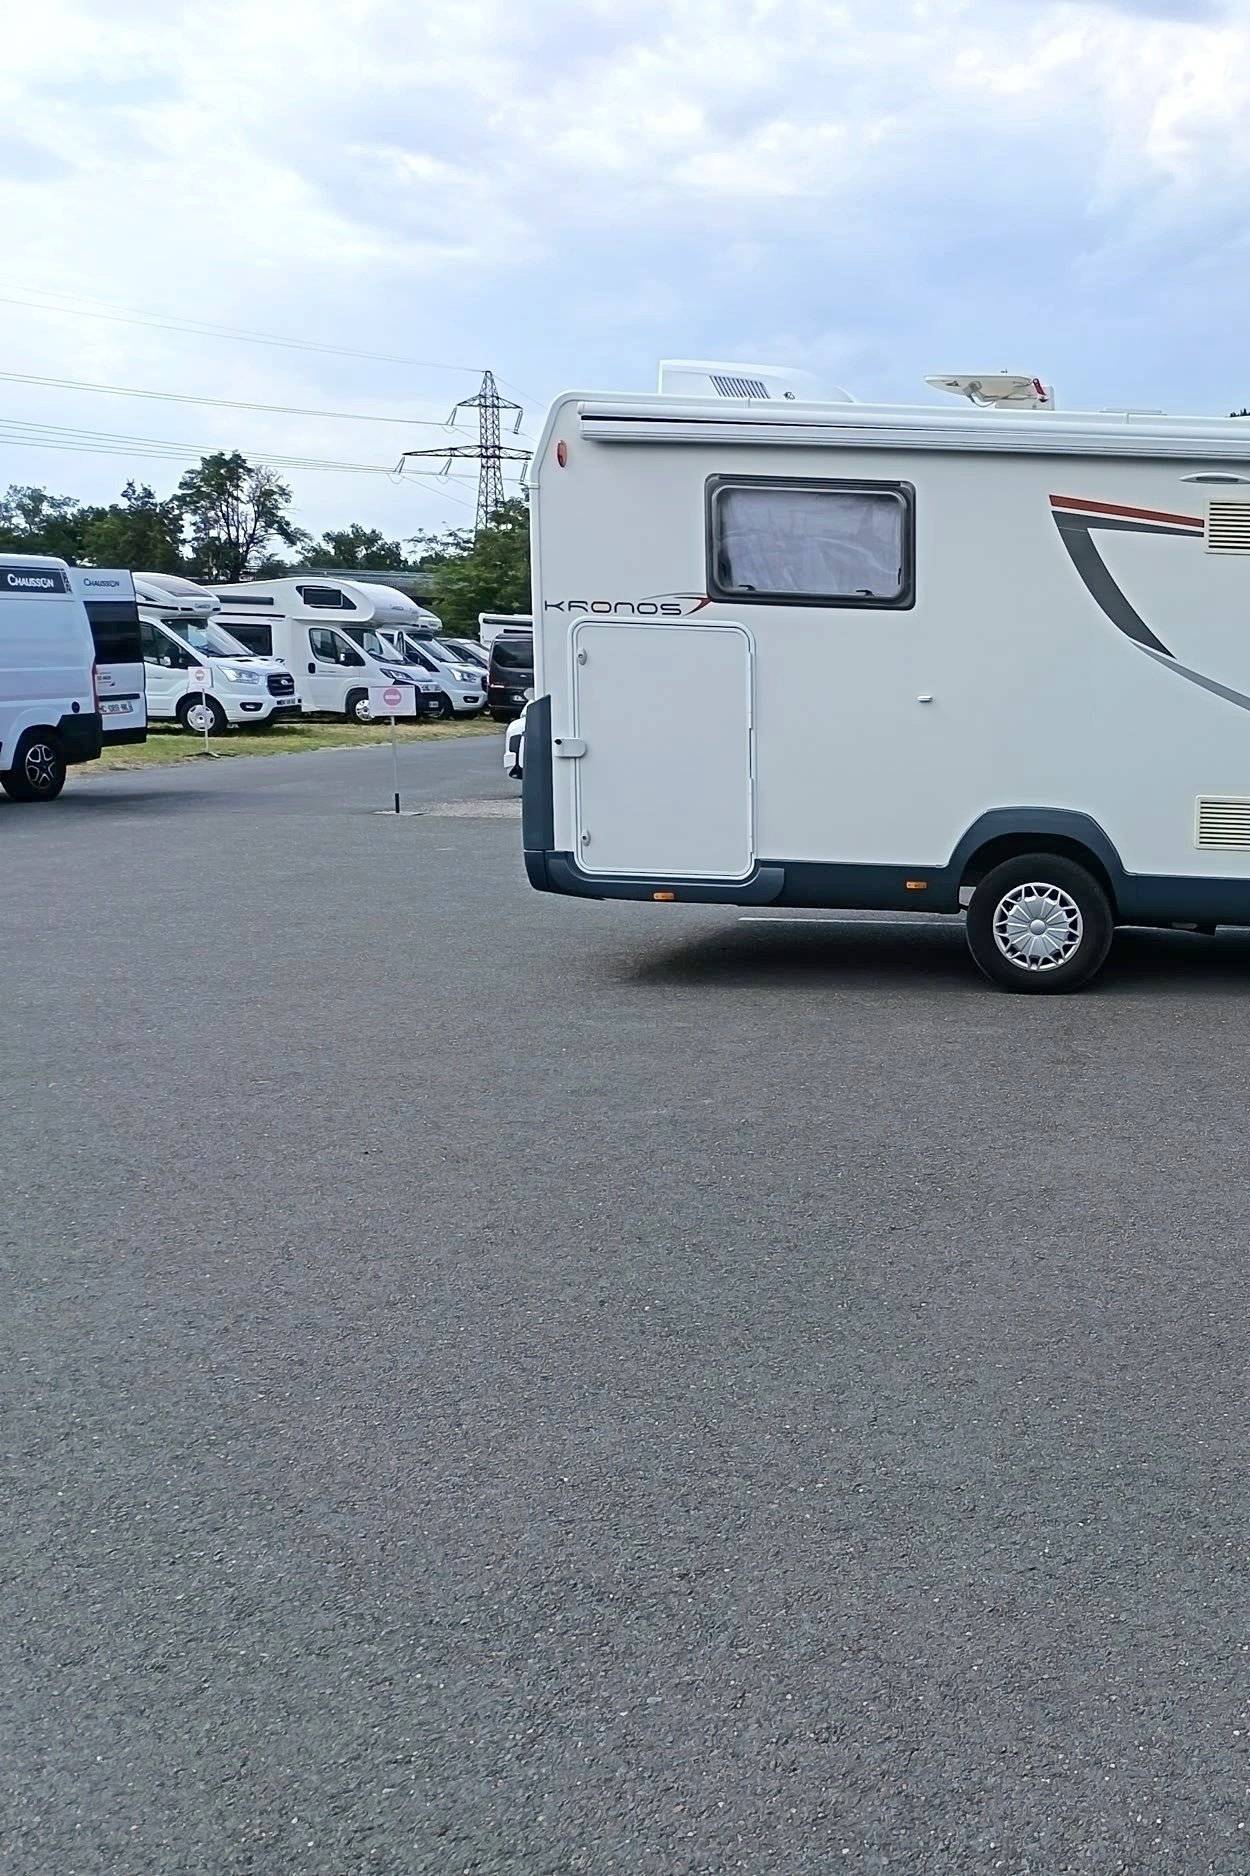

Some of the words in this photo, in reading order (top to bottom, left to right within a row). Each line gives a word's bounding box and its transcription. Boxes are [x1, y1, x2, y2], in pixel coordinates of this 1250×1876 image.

[7, 574, 54, 588] CHAUSSON
[83, 578, 120, 588] CHAUSSON
[544, 600, 682, 616] KRONOS
